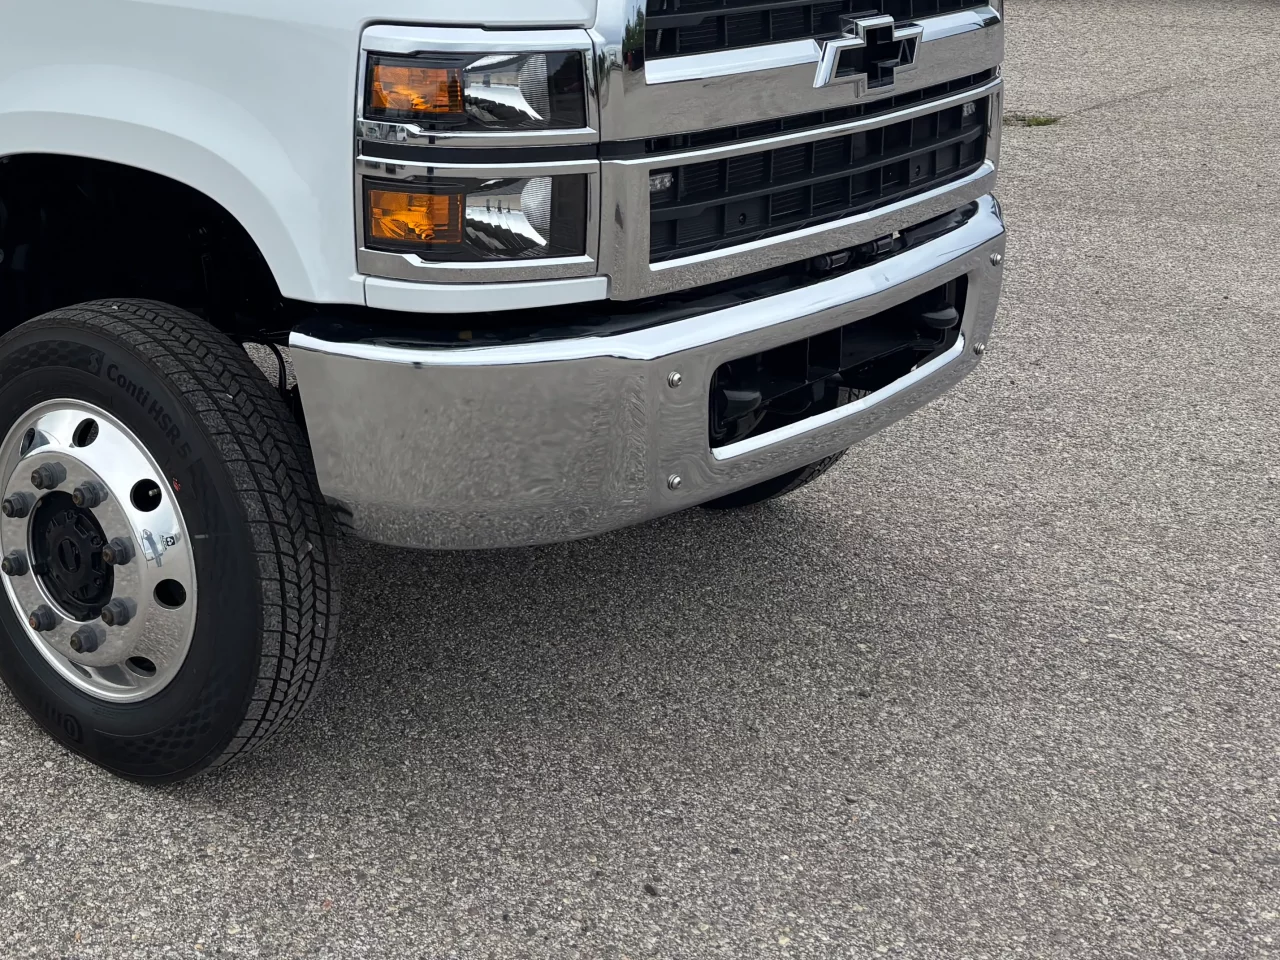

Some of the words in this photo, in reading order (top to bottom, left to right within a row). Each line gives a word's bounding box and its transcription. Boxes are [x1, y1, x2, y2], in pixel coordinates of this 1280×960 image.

[106, 363, 150, 408] Conti
[147, 399, 182, 446] HSR
[176, 441, 193, 461] 5
